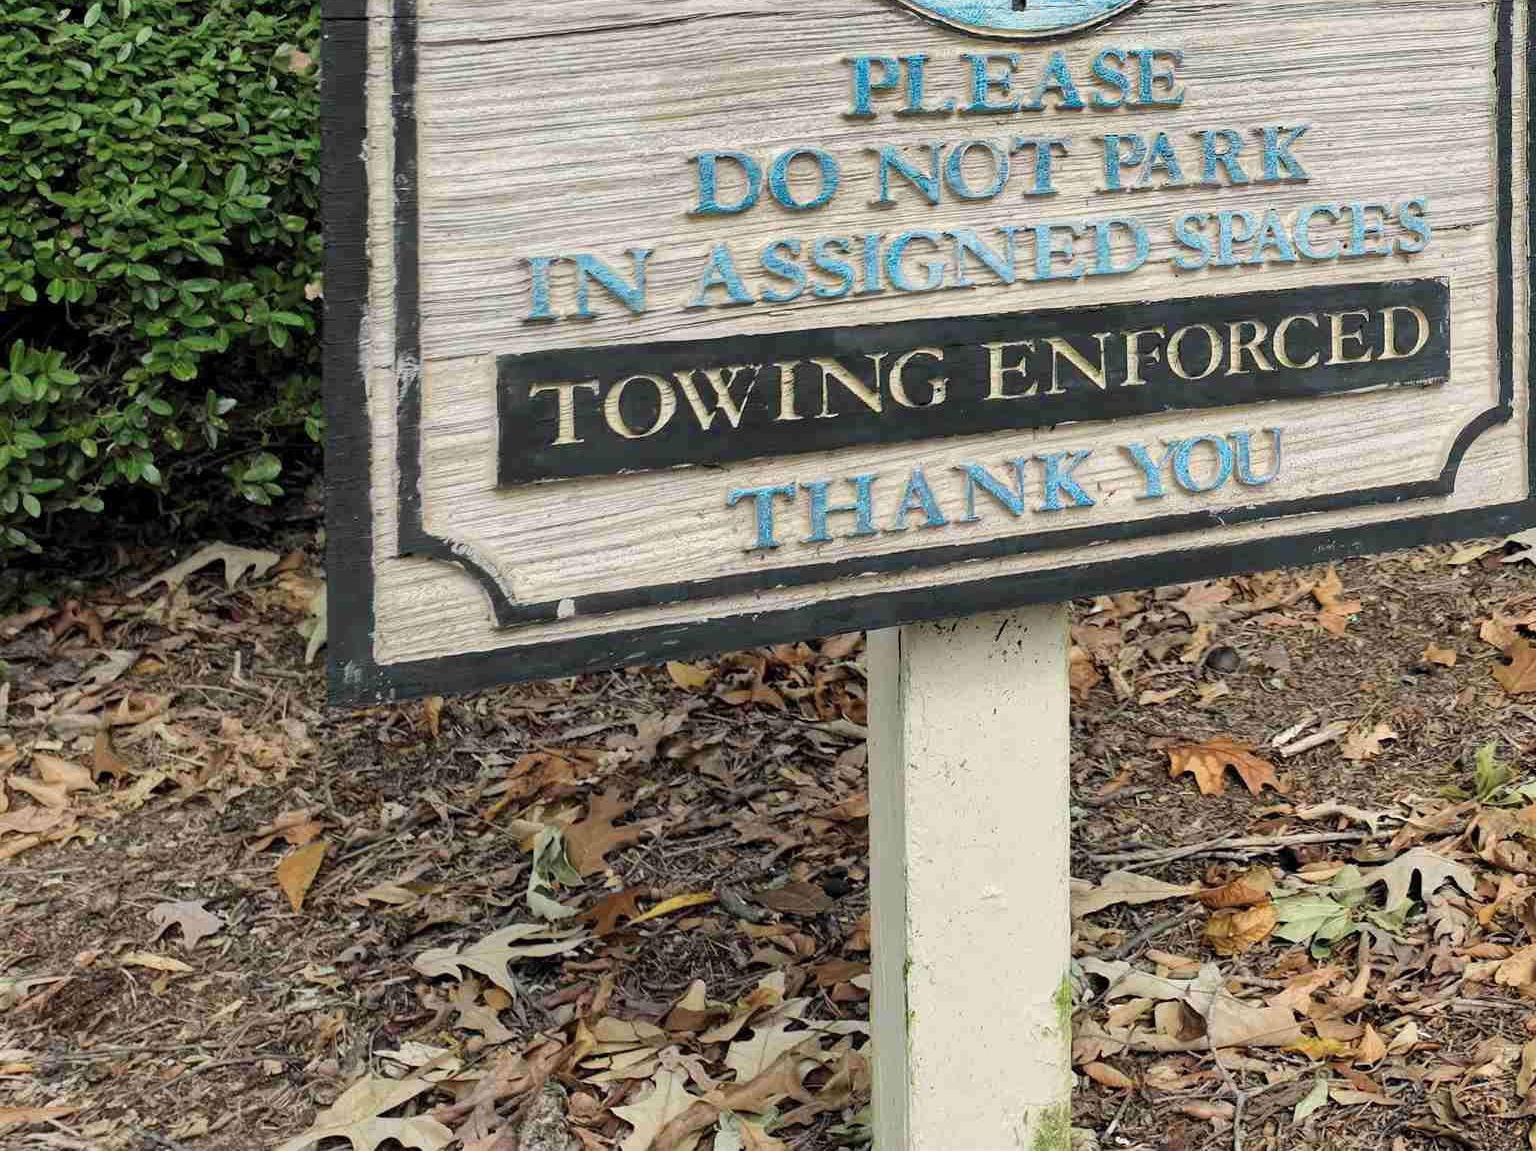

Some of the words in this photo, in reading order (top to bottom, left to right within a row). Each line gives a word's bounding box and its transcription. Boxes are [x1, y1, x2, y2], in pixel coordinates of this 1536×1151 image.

[846, 48, 1187, 119] PLEASE
[687, 148, 841, 216] DO
[873, 136, 1071, 207] NOT
[1099, 123, 1311, 192] PARK
[522, 247, 654, 323] IN
[691, 217, 1151, 308] ASSIGNED
[1172, 198, 1434, 271] SPACES
[530, 346, 948, 446] TOWING
[982, 306, 1431, 400] ENFORCED
[727, 451, 1096, 551] THANK
[1124, 427, 1283, 501] YOU
